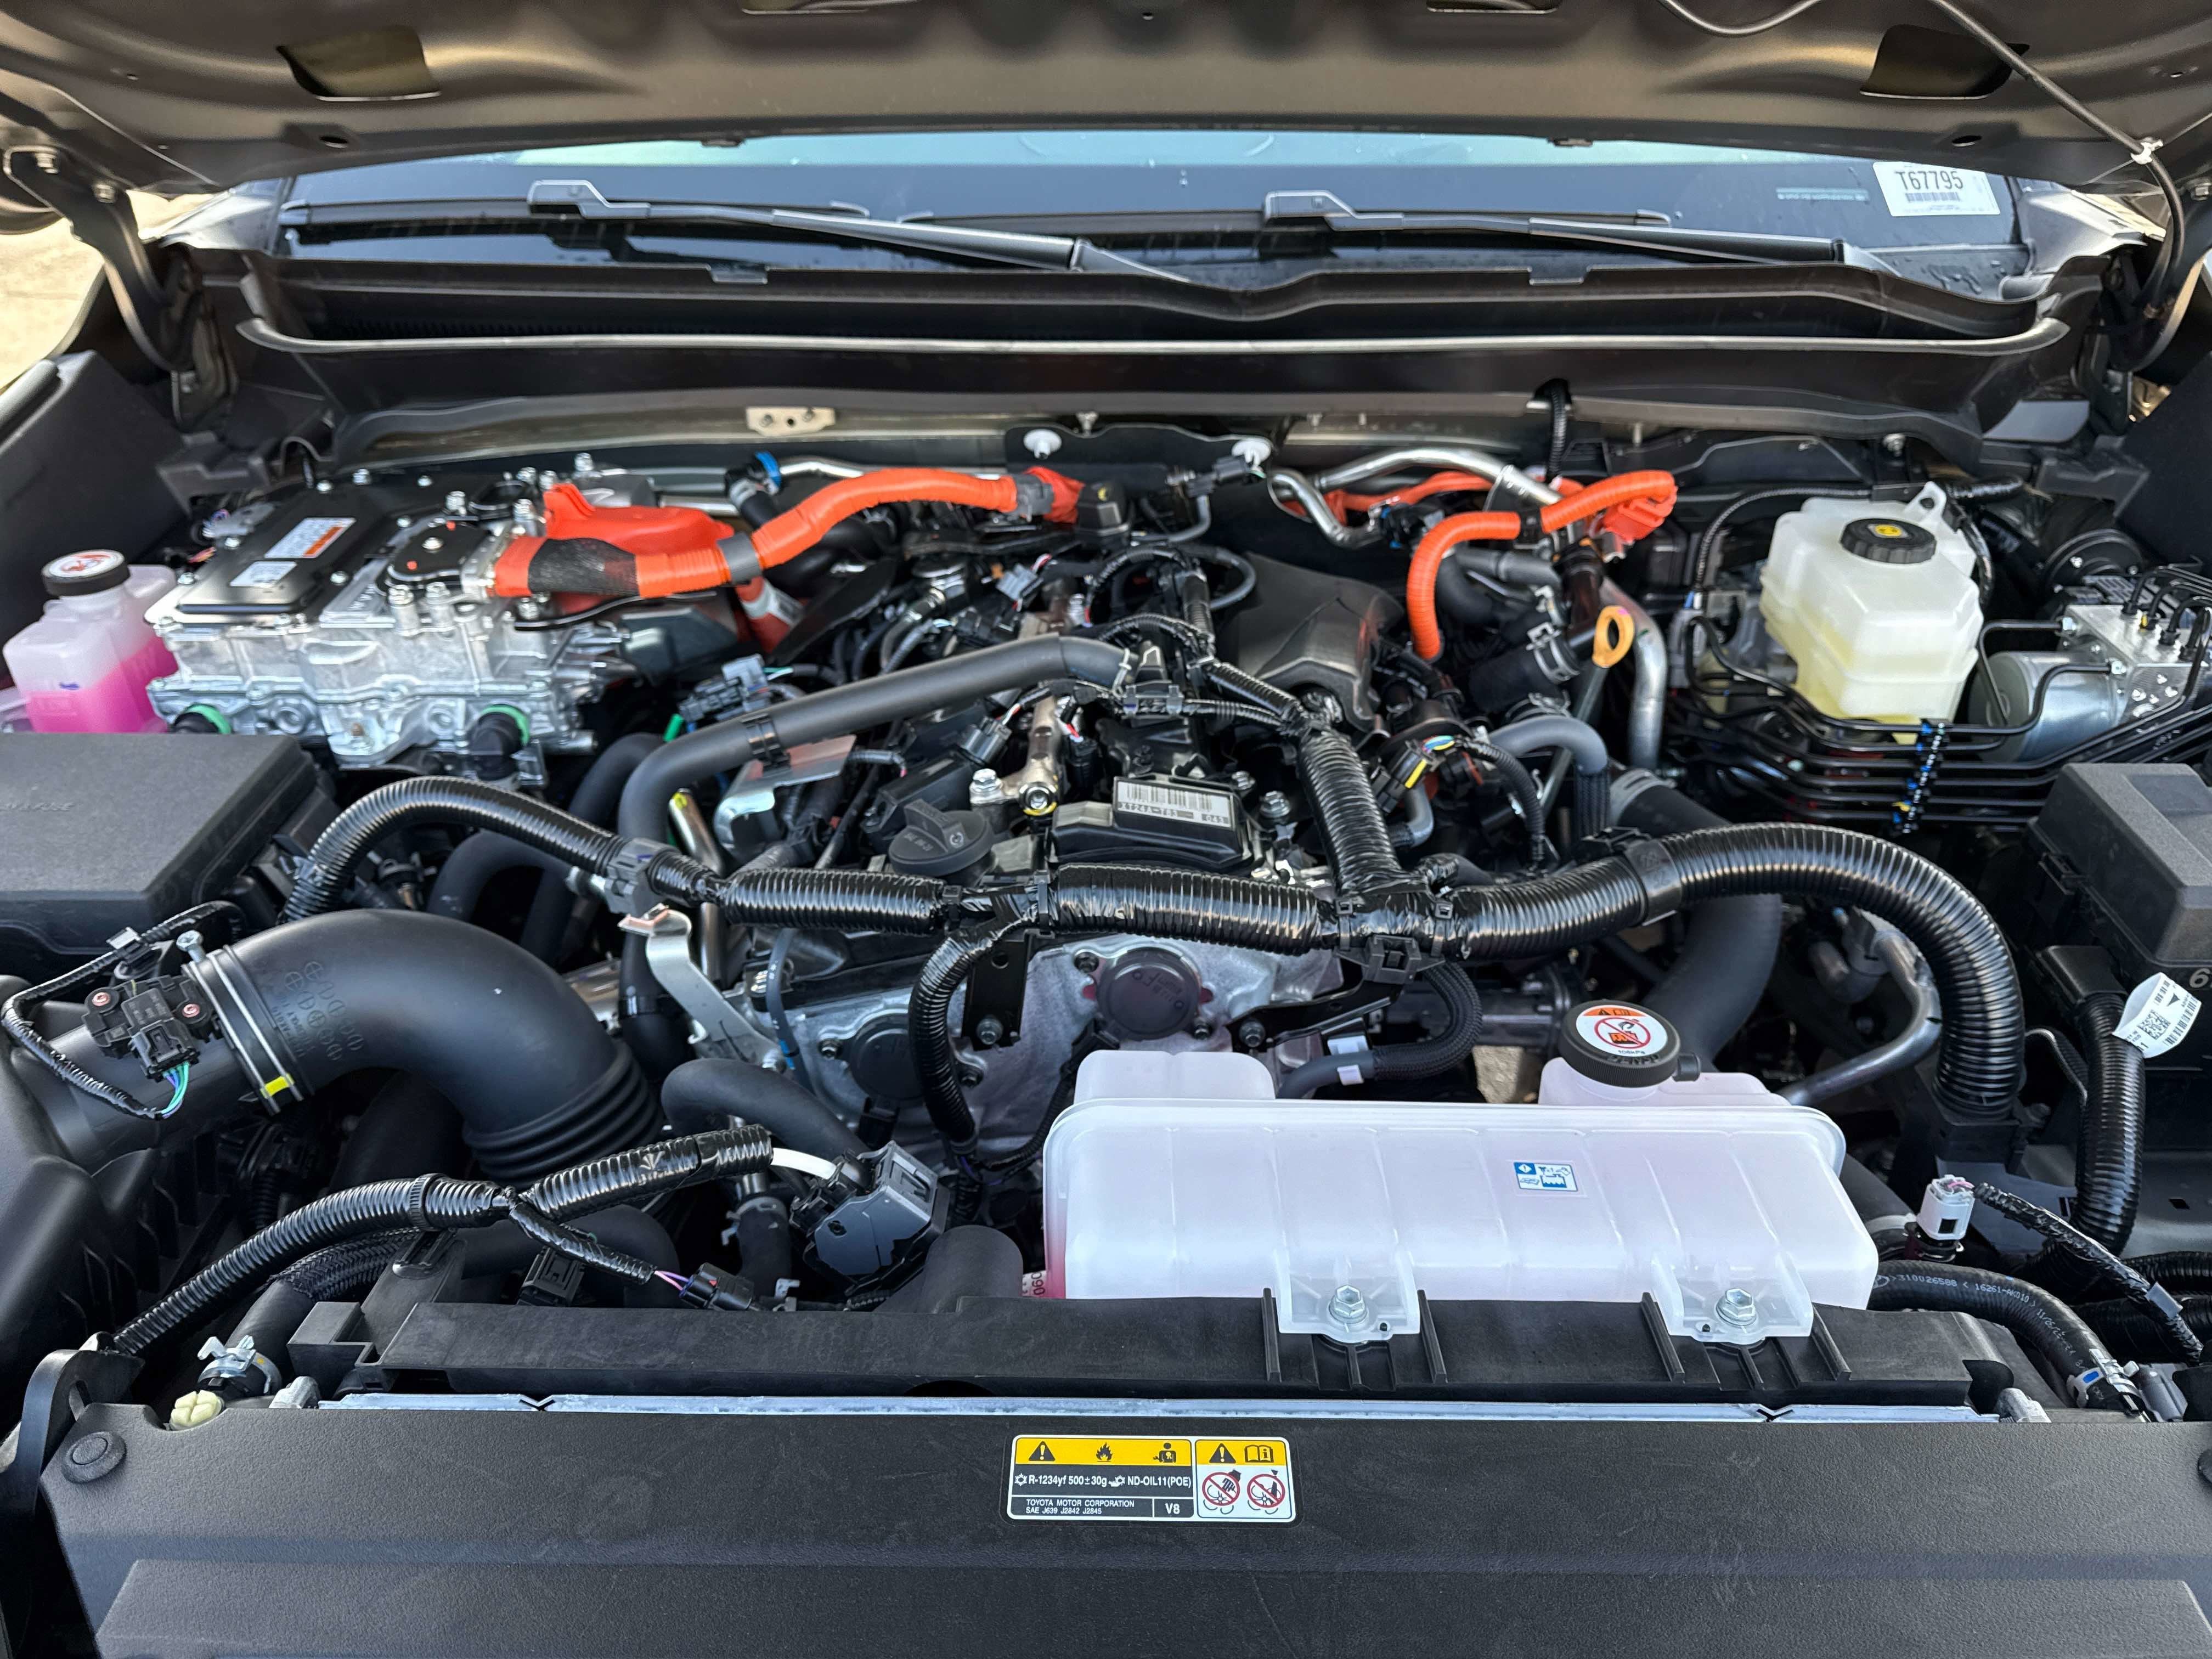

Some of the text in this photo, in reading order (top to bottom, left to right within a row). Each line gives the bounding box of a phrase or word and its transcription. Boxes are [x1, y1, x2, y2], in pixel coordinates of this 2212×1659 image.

[1894, 171, 1963, 190] T67795
[2190, 968, 2212, 988] 6
[1975, 1283, 2030, 1303] 16261-AK010
[1028, 1475, 1191, 1488] R-1234yf 500±30g ND-OIL11(POE)
[1085, 1499, 1135, 1508] CORPORATION
[1165, 1503, 1180, 1515] V8
